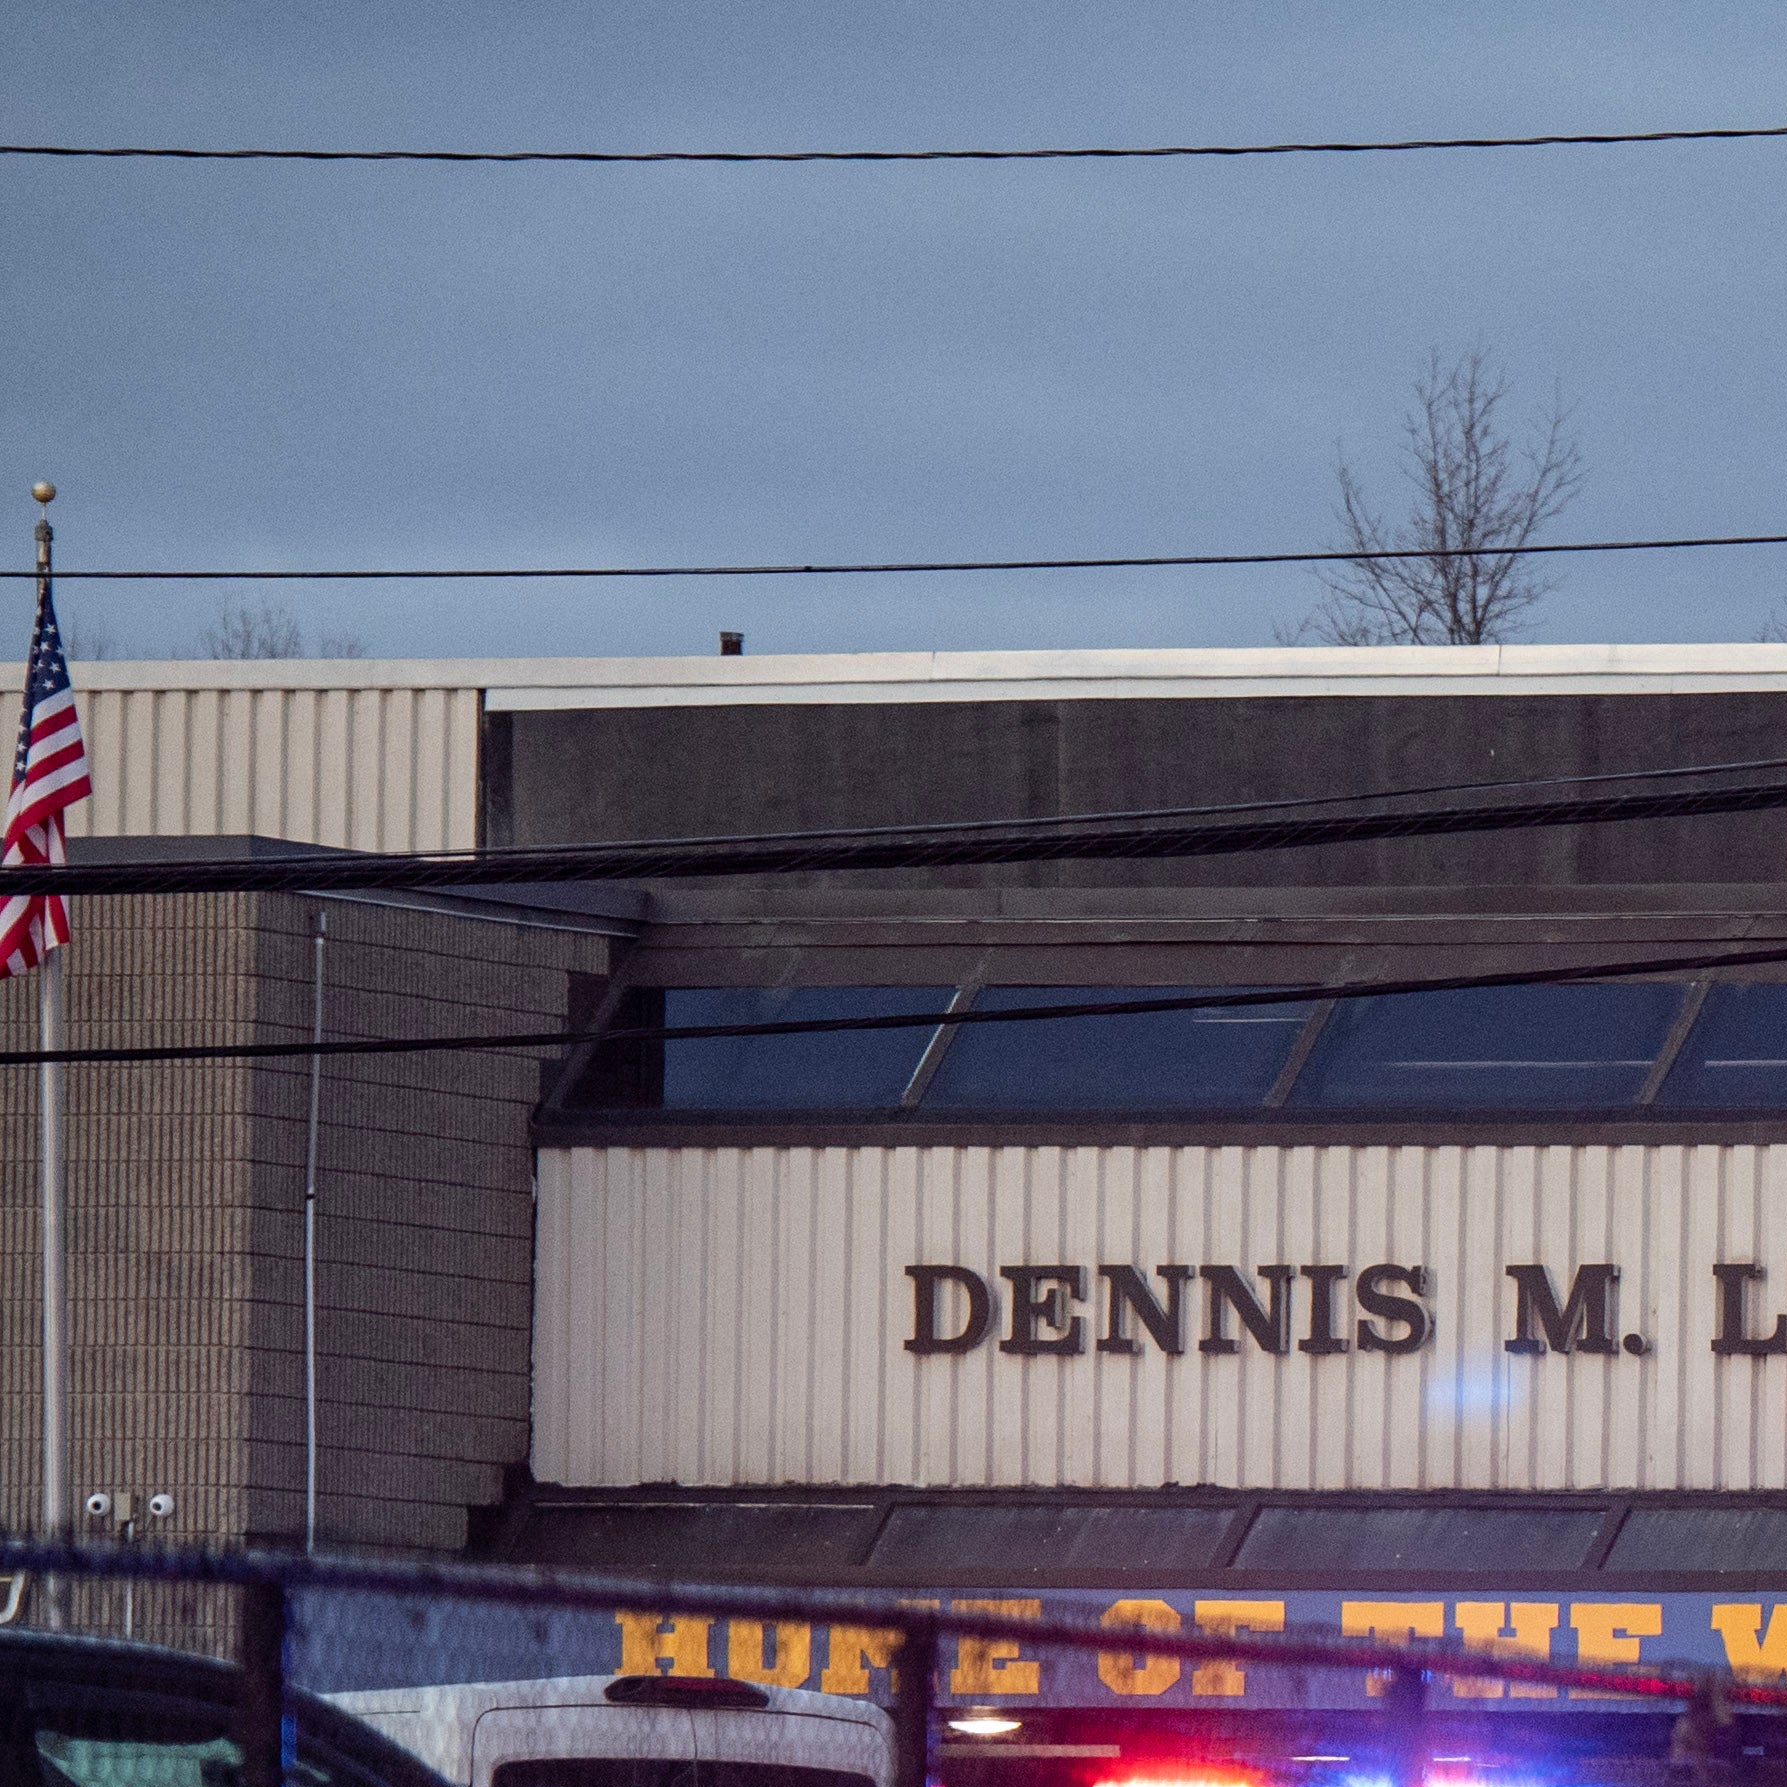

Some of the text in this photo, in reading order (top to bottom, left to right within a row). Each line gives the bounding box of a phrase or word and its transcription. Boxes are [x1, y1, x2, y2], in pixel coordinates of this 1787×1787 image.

[903, 1262, 1436, 1356] DENNIS
[1504, 1262, 1654, 1356] M.
[613, 1598, 1041, 1697] HOME
[1096, 1598, 1286, 1698] OF
[1340, 1600, 1666, 1700] THE
